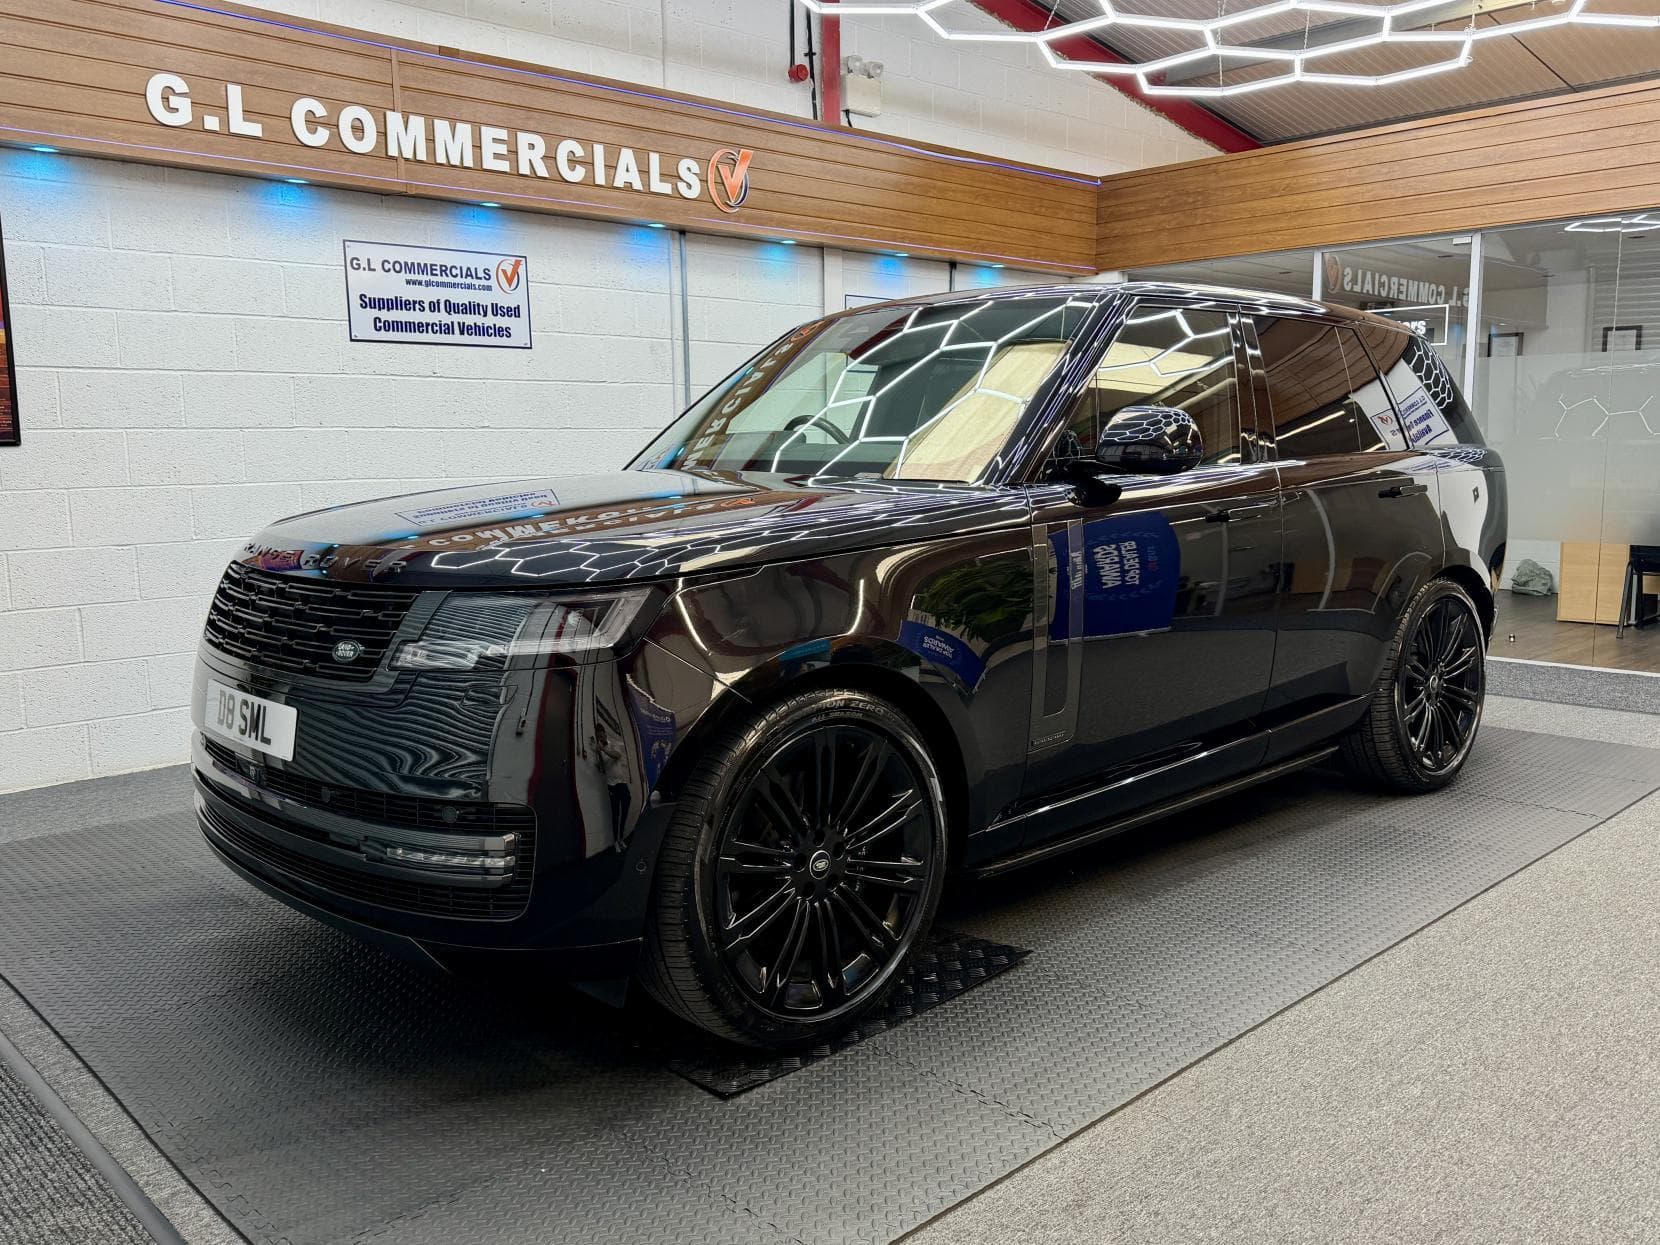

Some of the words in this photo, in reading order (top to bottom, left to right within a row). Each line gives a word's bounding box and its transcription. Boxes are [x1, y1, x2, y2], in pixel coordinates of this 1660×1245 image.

[145, 73, 263, 137] G.L
[291, 98, 701, 199] COMMERCIALS
[350, 257, 376, 272] G.L
[381, 259, 491, 281] COMMERCIALS
[405, 278, 493, 292] www.glcommercials.com
[359, 293, 426, 313] Suppliers
[429, 299, 441, 313] of
[444, 300, 488, 318] Quality
[491, 302, 521, 318] Used
[373, 316, 455, 336] Commercial
[457, 321, 512, 338] Vehicles
[303, 554, 407, 574] ROVER
[217, 690, 236, 730] D8
[239, 698, 272, 746] SML
